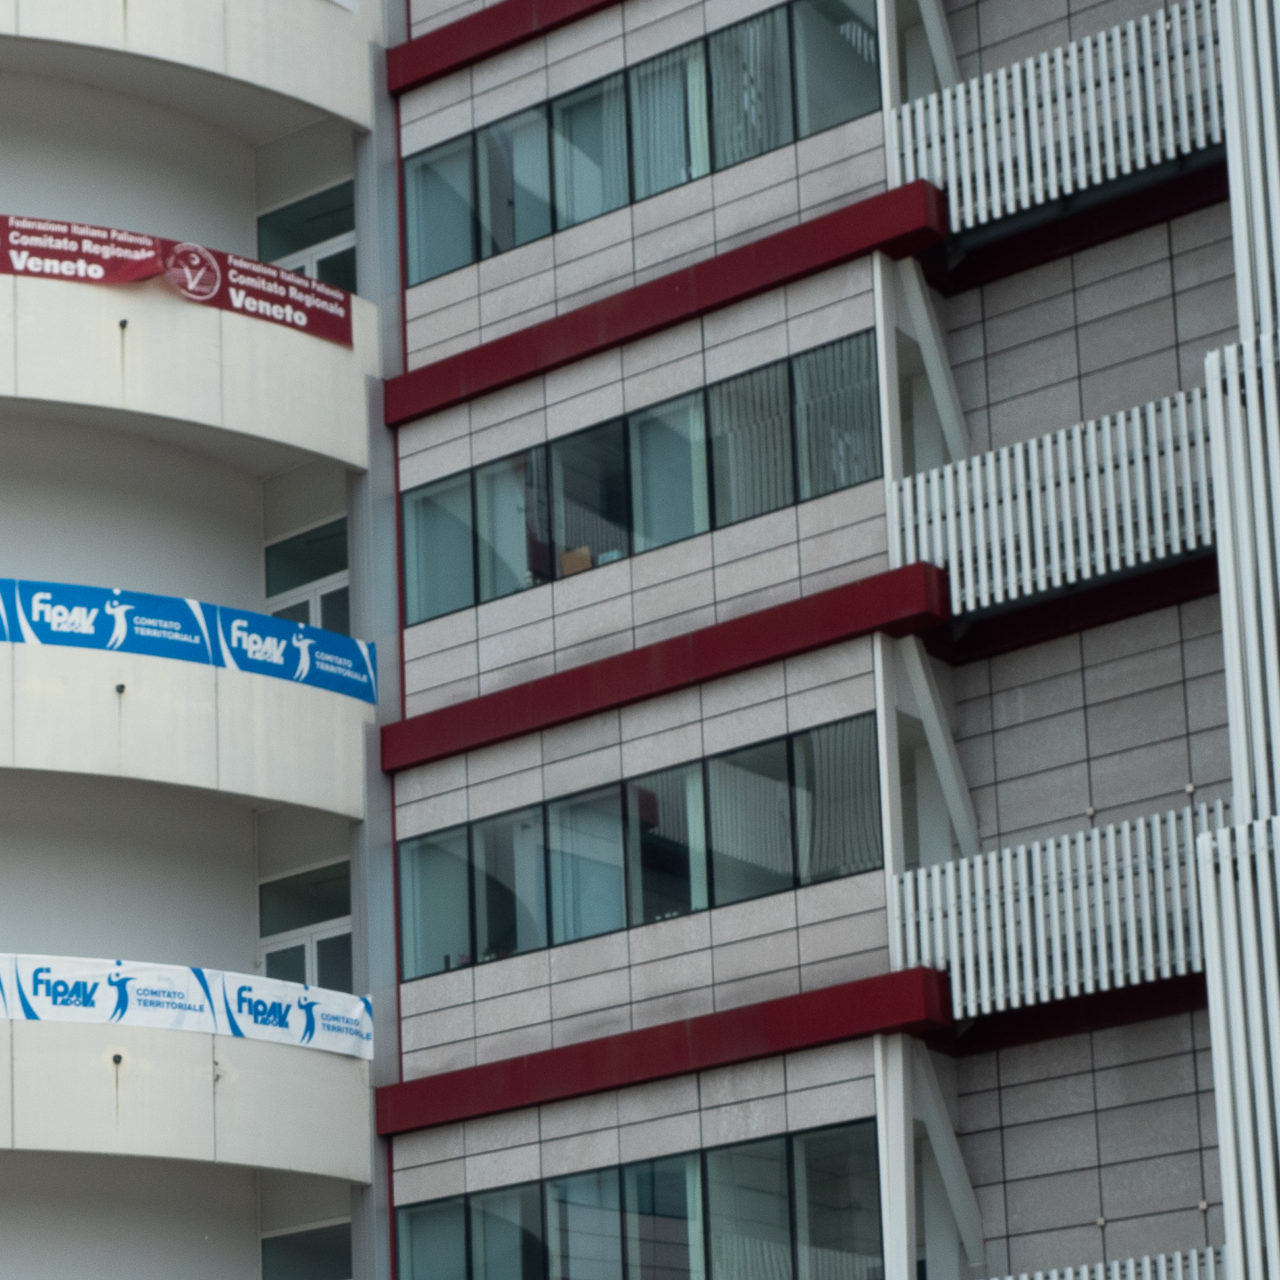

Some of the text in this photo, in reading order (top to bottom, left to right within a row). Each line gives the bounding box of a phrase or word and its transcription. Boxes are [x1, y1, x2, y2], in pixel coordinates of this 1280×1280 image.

[8, 231, 155, 261] Comitato Regionale
[9, 250, 105, 279] Veneto
[228, 270, 286, 297] Comitato
[289, 286, 345, 317] Regionale
[228, 287, 307, 326] Veneto
[133, 616, 181, 630] COMITATO
[134, 627, 201, 644] TERRITORIALE
[315, 650, 353, 667] COMITATO
[315, 661, 367, 683] TERRITORIALE
[136, 988, 184, 999] COMITATO
[137, 999, 205, 1012] TERRITORIALE
[321, 1013, 360, 1026] COMITATO
